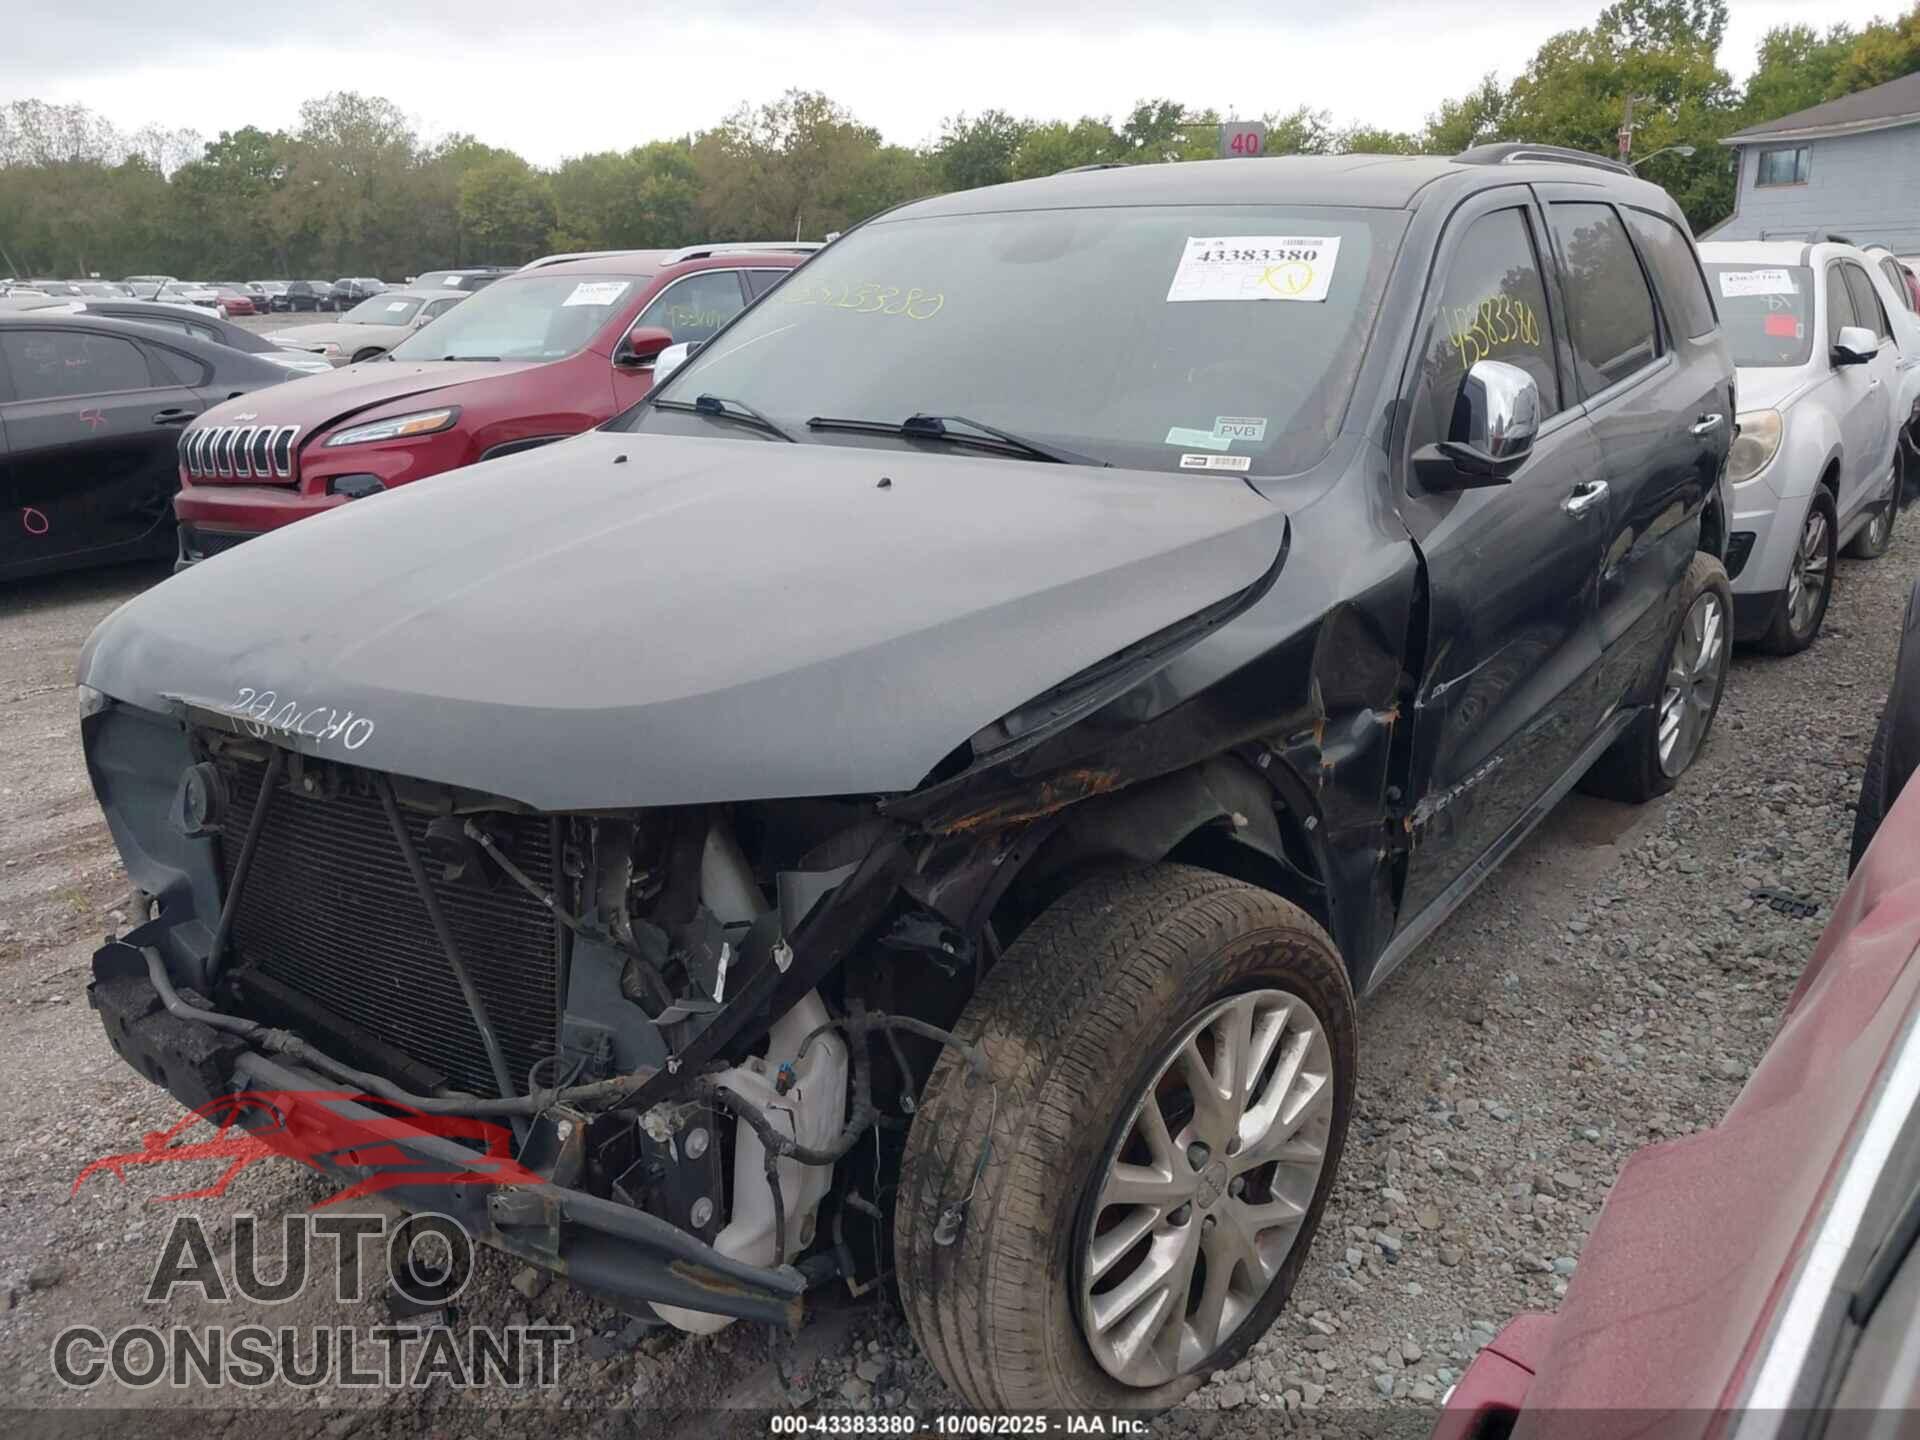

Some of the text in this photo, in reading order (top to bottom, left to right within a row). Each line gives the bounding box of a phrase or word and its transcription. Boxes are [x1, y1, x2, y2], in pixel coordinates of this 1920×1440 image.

[1231, 133, 1258, 154] 40
[1196, 249, 1318, 262] 43383380
[1220, 424, 1257, 437] PVB
